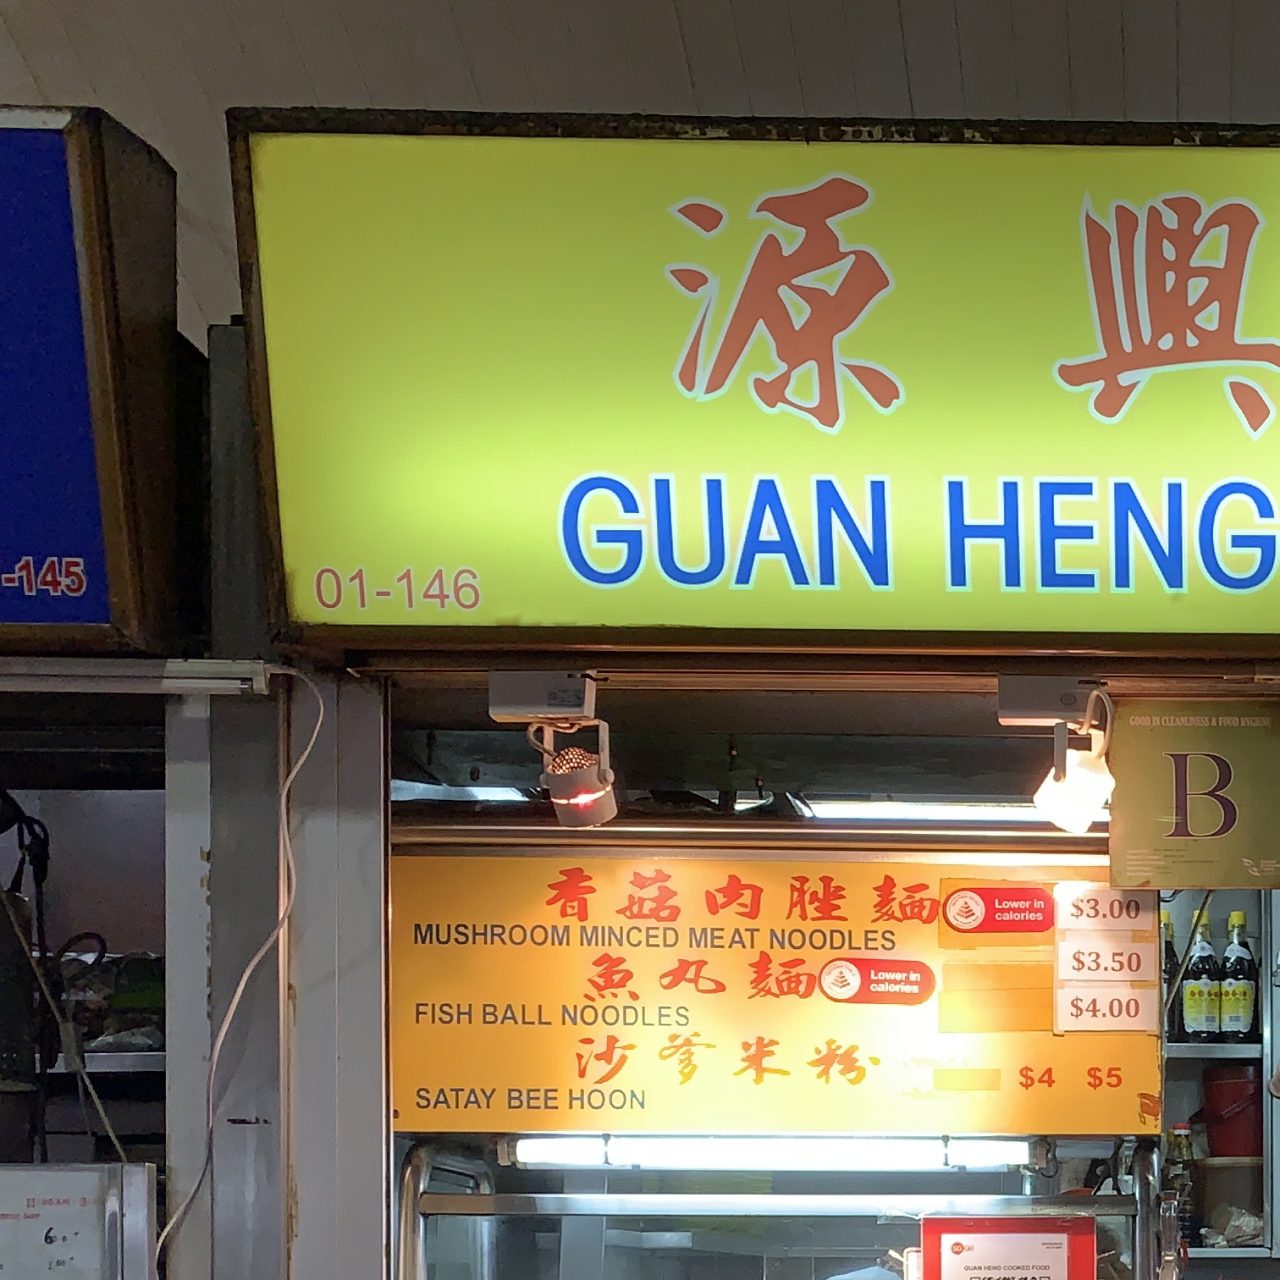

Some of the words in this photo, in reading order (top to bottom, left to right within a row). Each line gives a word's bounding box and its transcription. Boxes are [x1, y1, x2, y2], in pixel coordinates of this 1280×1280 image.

[561, 474, 889, 588] GUAN
[946, 478, 1279, 591] HENG
[314, 566, 482, 611] 01-146
[1129, 716, 1151, 727] GOOD
[1162, 751, 1239, 839] B
[994, 898, 1030, 909] Lower
[1033, 897, 1045, 909] in
[1070, 897, 1141, 920] $3.00
[994, 910, 1044, 921] calories
[413, 923, 571, 948] MUSHROOM
[578, 925, 681, 950] MINCED
[687, 927, 761, 951] MEAT
[767, 928, 897, 952] NOODLES
[1071, 950, 1142, 973] $3.50
[869, 968, 902, 981] Lower
[907, 969, 921, 982] in
[869, 981, 920, 994] calories
[413, 1002, 478, 1026] FISH
[481, 1003, 552, 1027] BALL
[560, 1003, 691, 1028] NOODLES
[1069, 996, 1141, 1021] $4.00
[1018, 1065, 1056, 1090] $4
[1086, 1065, 1123, 1090] $5
[414, 1087, 499, 1110] SATAY
[506, 1087, 562, 1110] BEE
[568, 1087, 647, 1111] HOON
